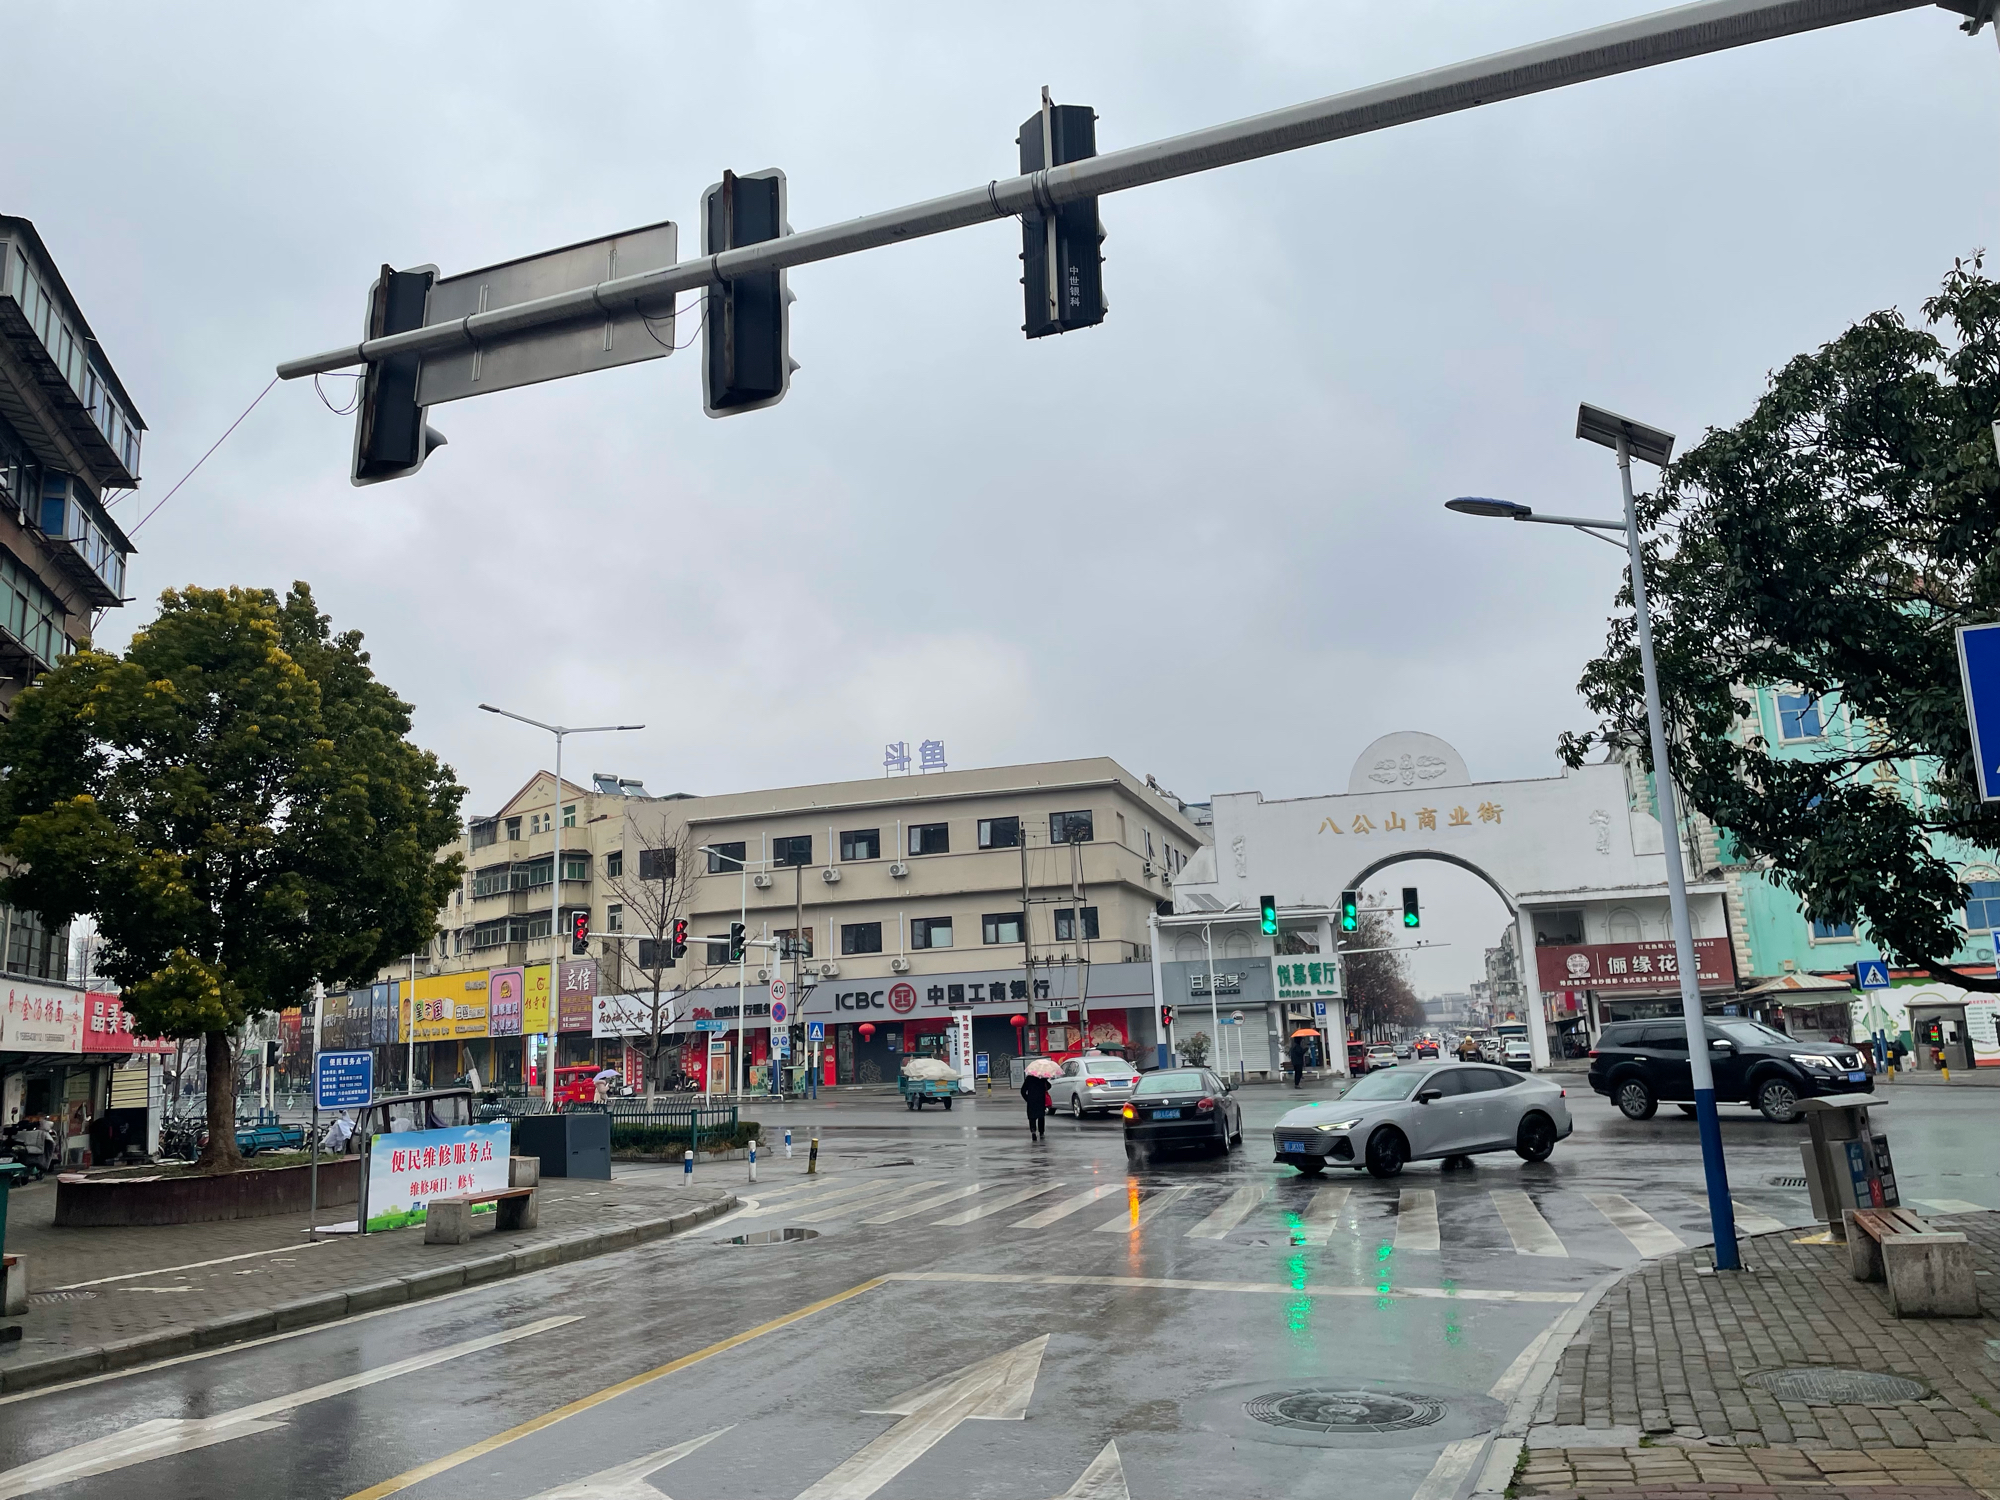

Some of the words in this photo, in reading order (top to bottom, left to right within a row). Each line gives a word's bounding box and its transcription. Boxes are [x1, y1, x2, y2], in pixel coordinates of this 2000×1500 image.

[1069, 265, 1080, 307] 中世银科
[883, 739, 948, 771] 斗鱼
[1318, 801, 1504, 835] 八公山商业街
[565, 967, 591, 991] 立信
[773, 985, 784, 994] 40
[835, 990, 884, 1011] ICBC
[927, 979, 1050, 1005] 中国工商银行
[1317, 1003, 1325, 1014] P
[391, 1140, 493, 1174] 便民维修服务点
[457, 1173, 475, 1190] 修车
